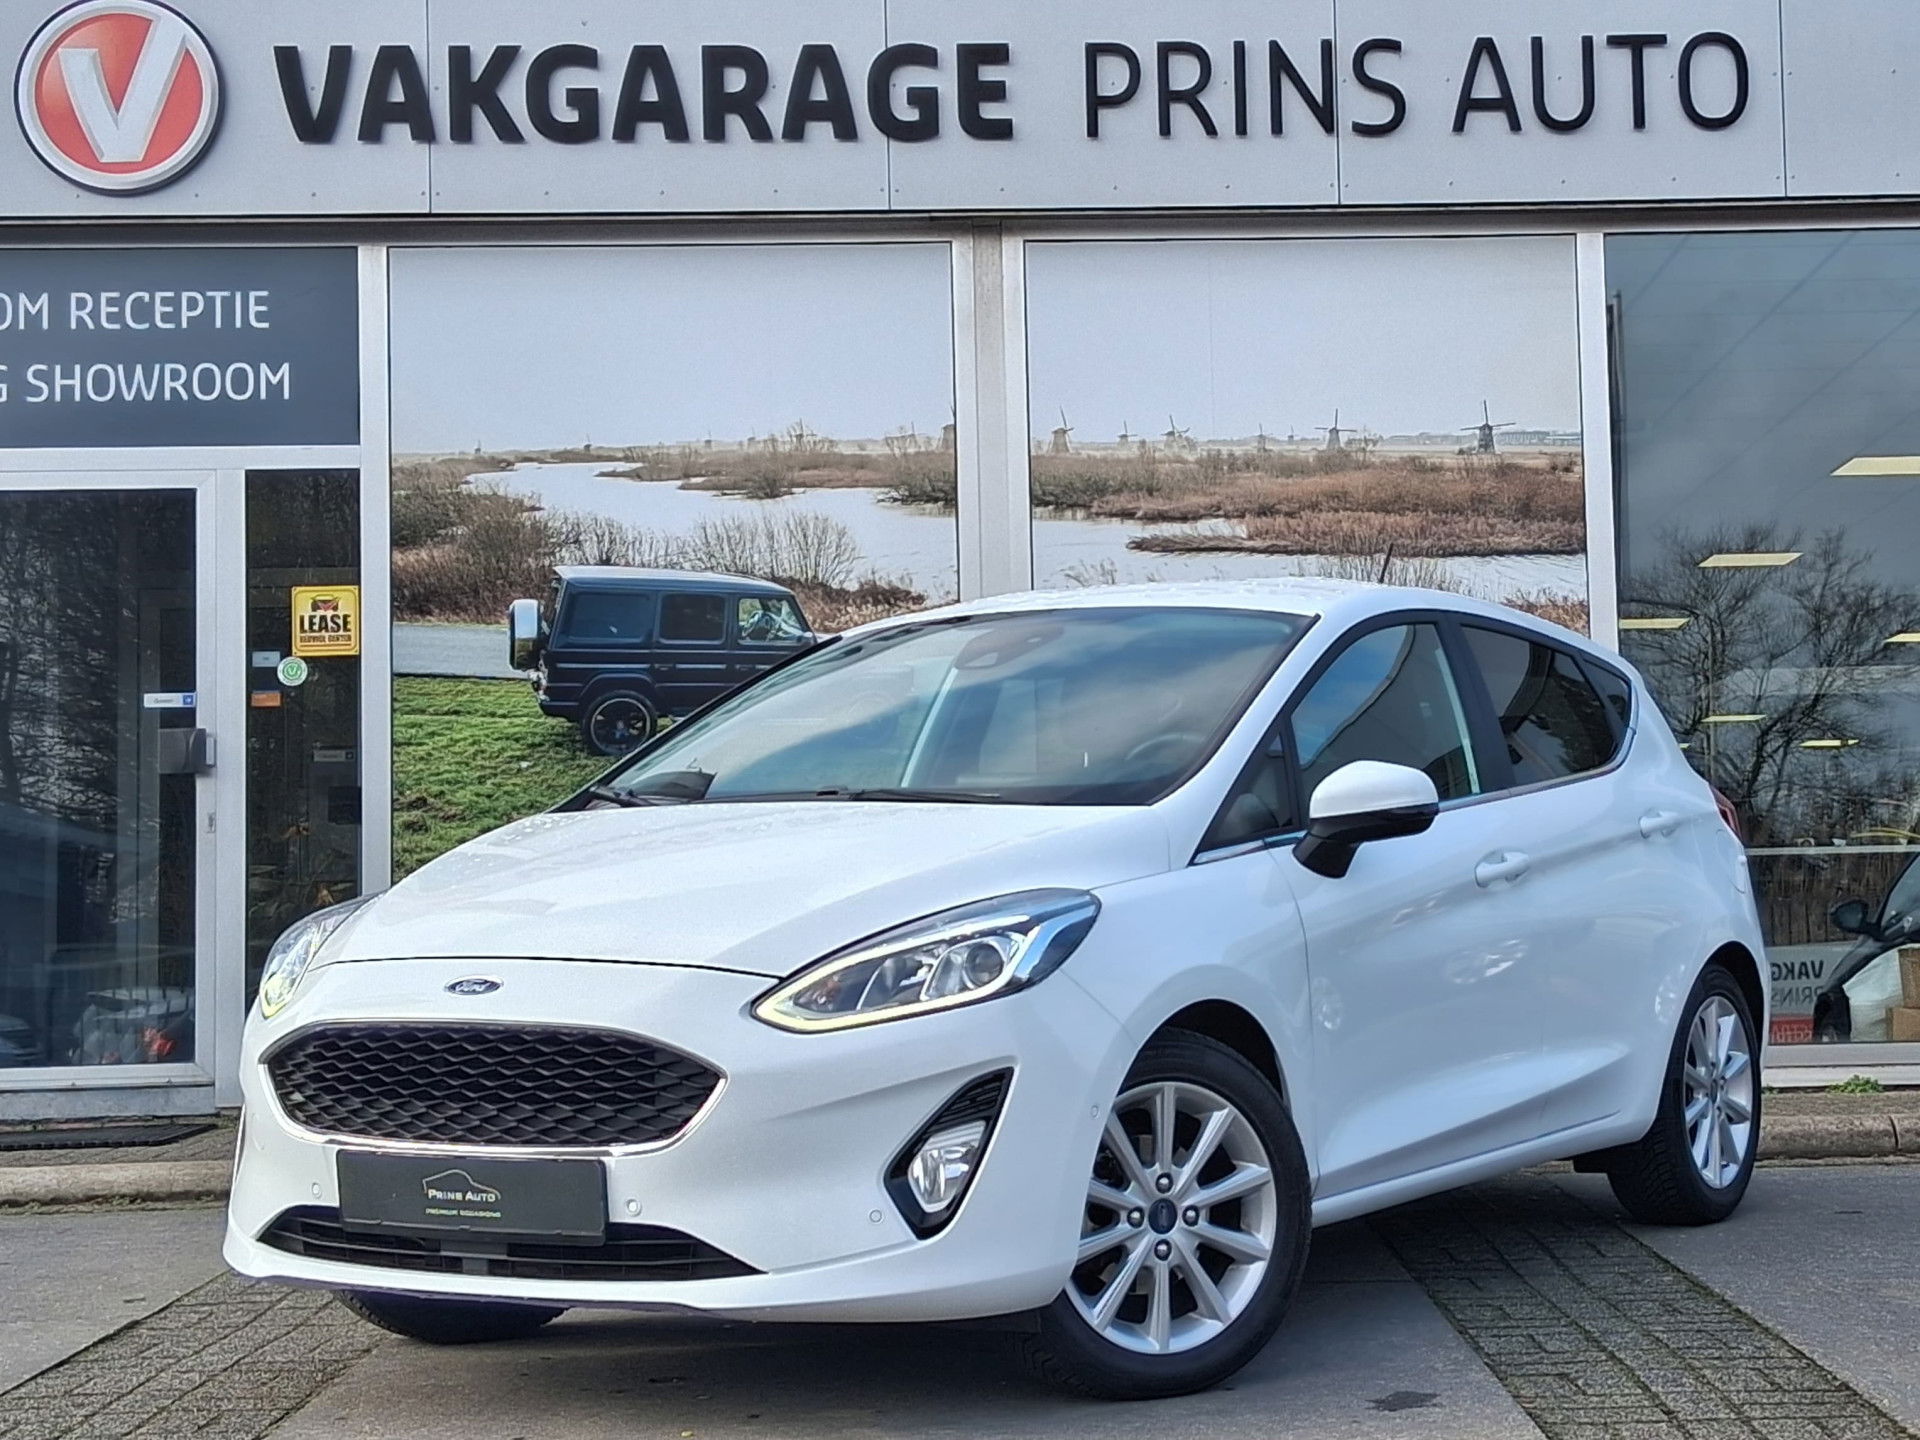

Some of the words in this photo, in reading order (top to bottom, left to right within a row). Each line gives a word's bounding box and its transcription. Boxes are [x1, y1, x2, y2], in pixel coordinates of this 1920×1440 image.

[273, 44, 1014, 145] VAKGARAGE
[1084, 39, 1407, 139] PRINS
[1452, 32, 1749, 134] AUTO
[70, 291, 270, 330] RECEPTIE
[26, 363, 290, 402] SHOWROOM
[300, 614, 351, 633] LEASE
